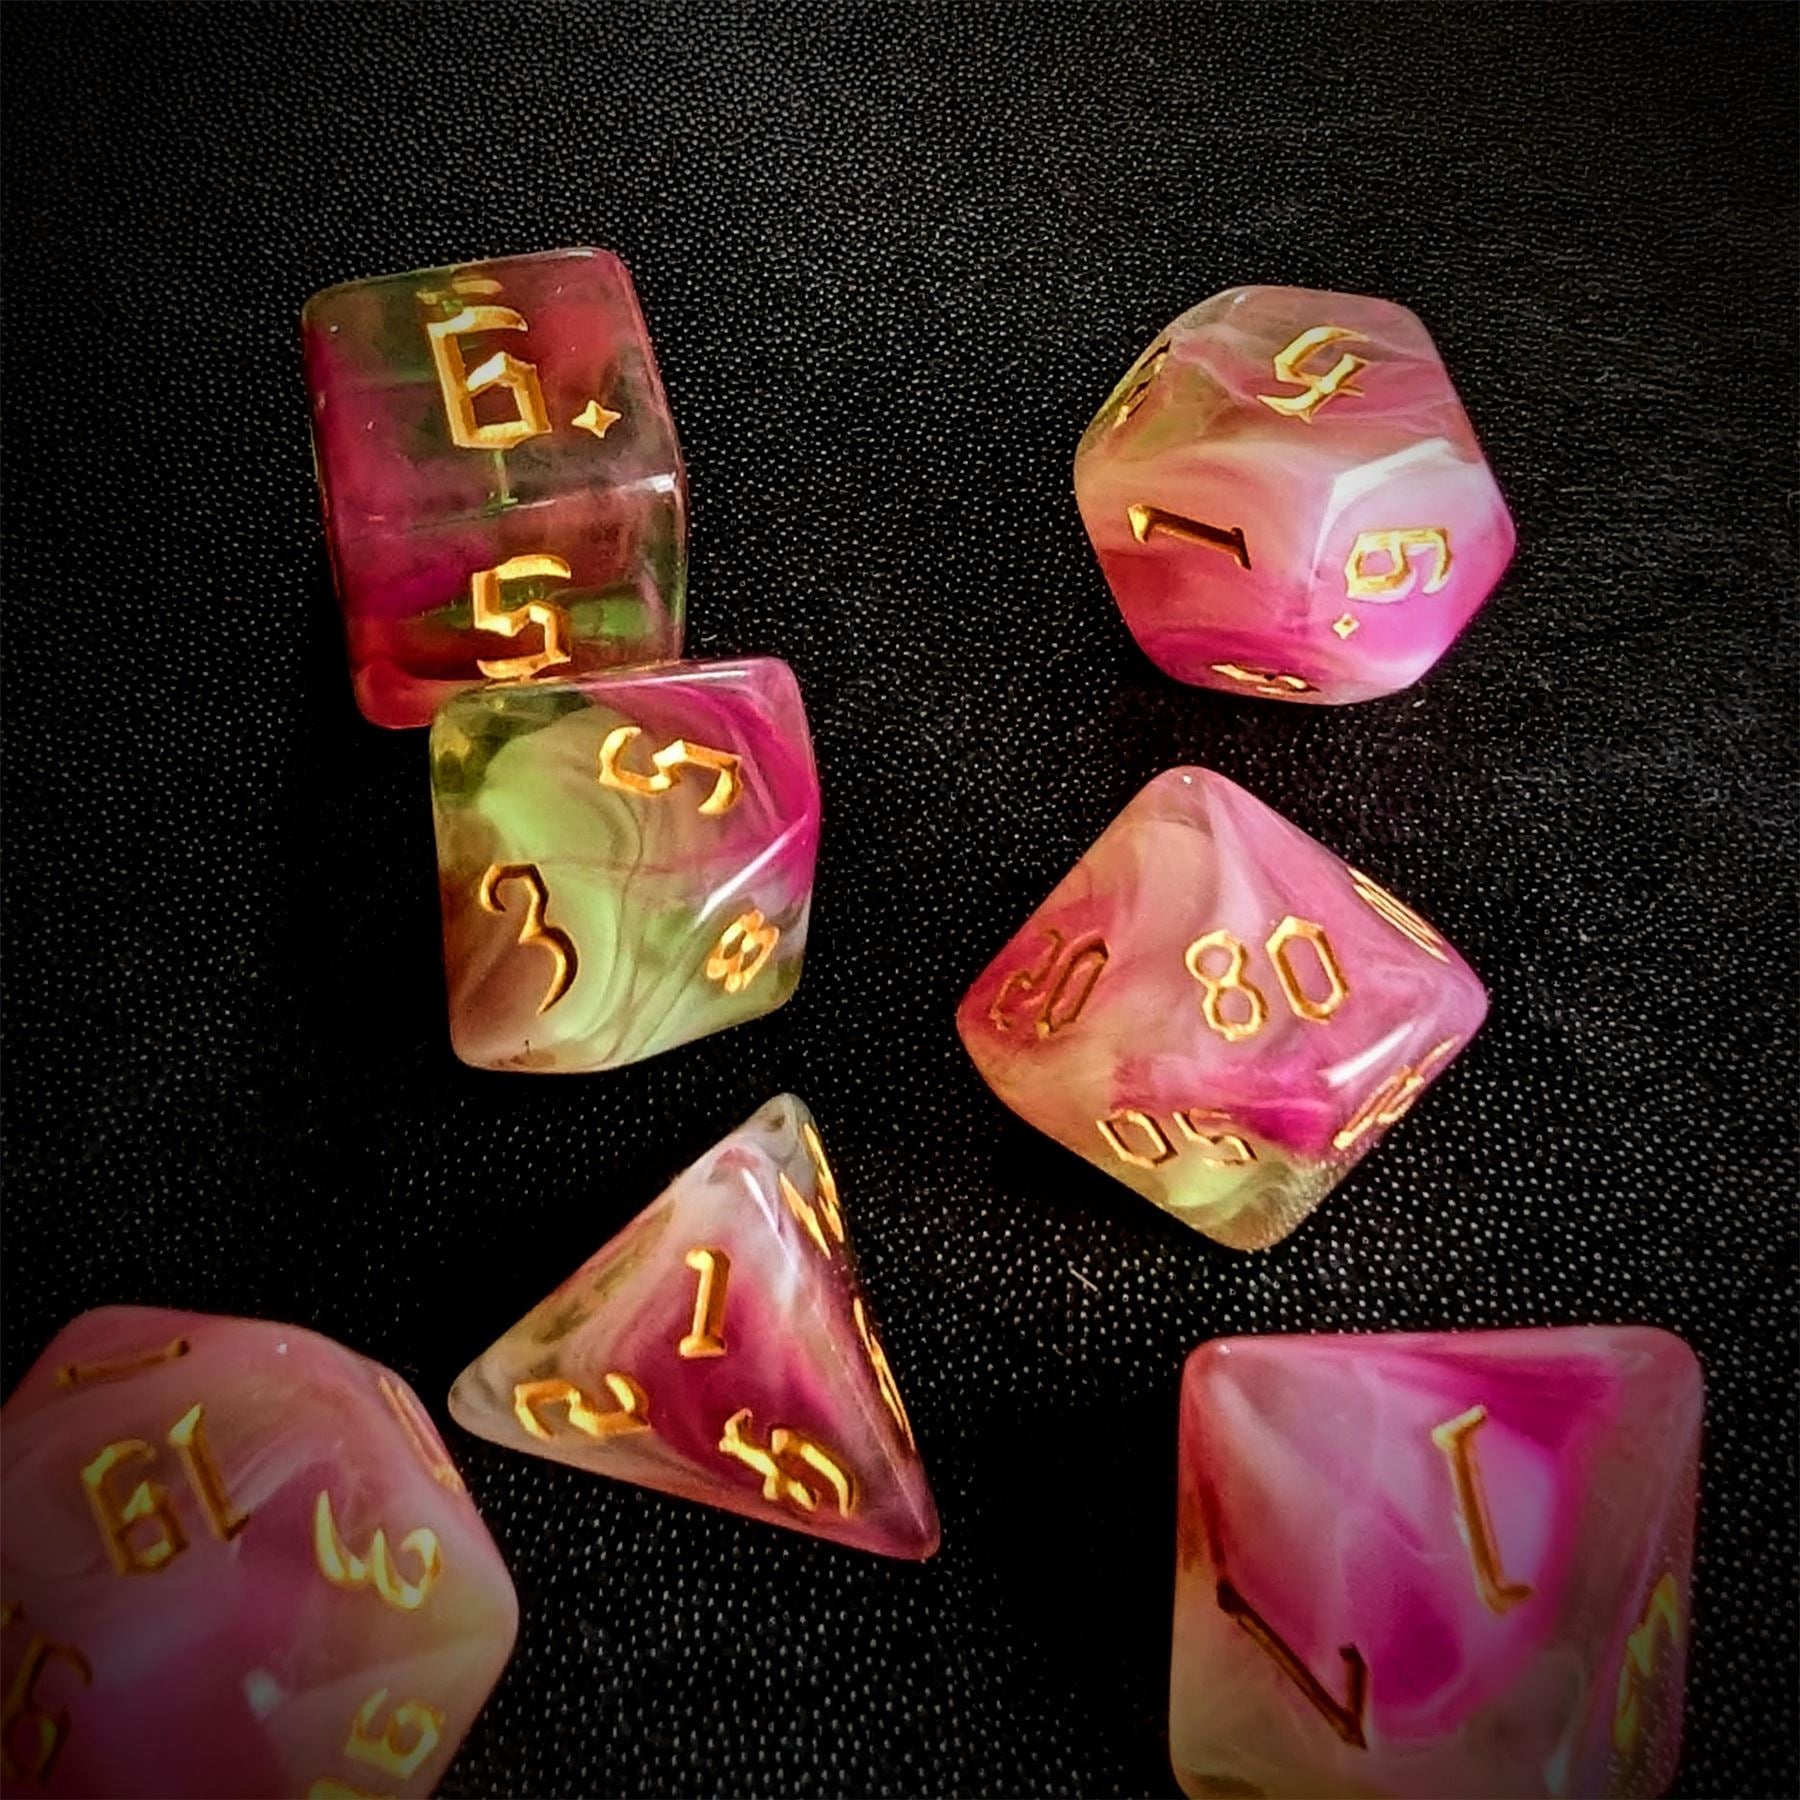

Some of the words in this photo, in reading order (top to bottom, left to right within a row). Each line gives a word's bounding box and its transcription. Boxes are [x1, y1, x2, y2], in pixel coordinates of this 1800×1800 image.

[427, 306, 552, 450] 6
[471, 554, 573, 680] 5
[599, 726, 743, 816] 5
[479, 861, 580, 1017] 3
[706, 908, 781, 994] 8
[1184, 915, 1350, 1042] 80
[677, 1248, 732, 1360] 1
[312, 1489, 444, 1611] 3
